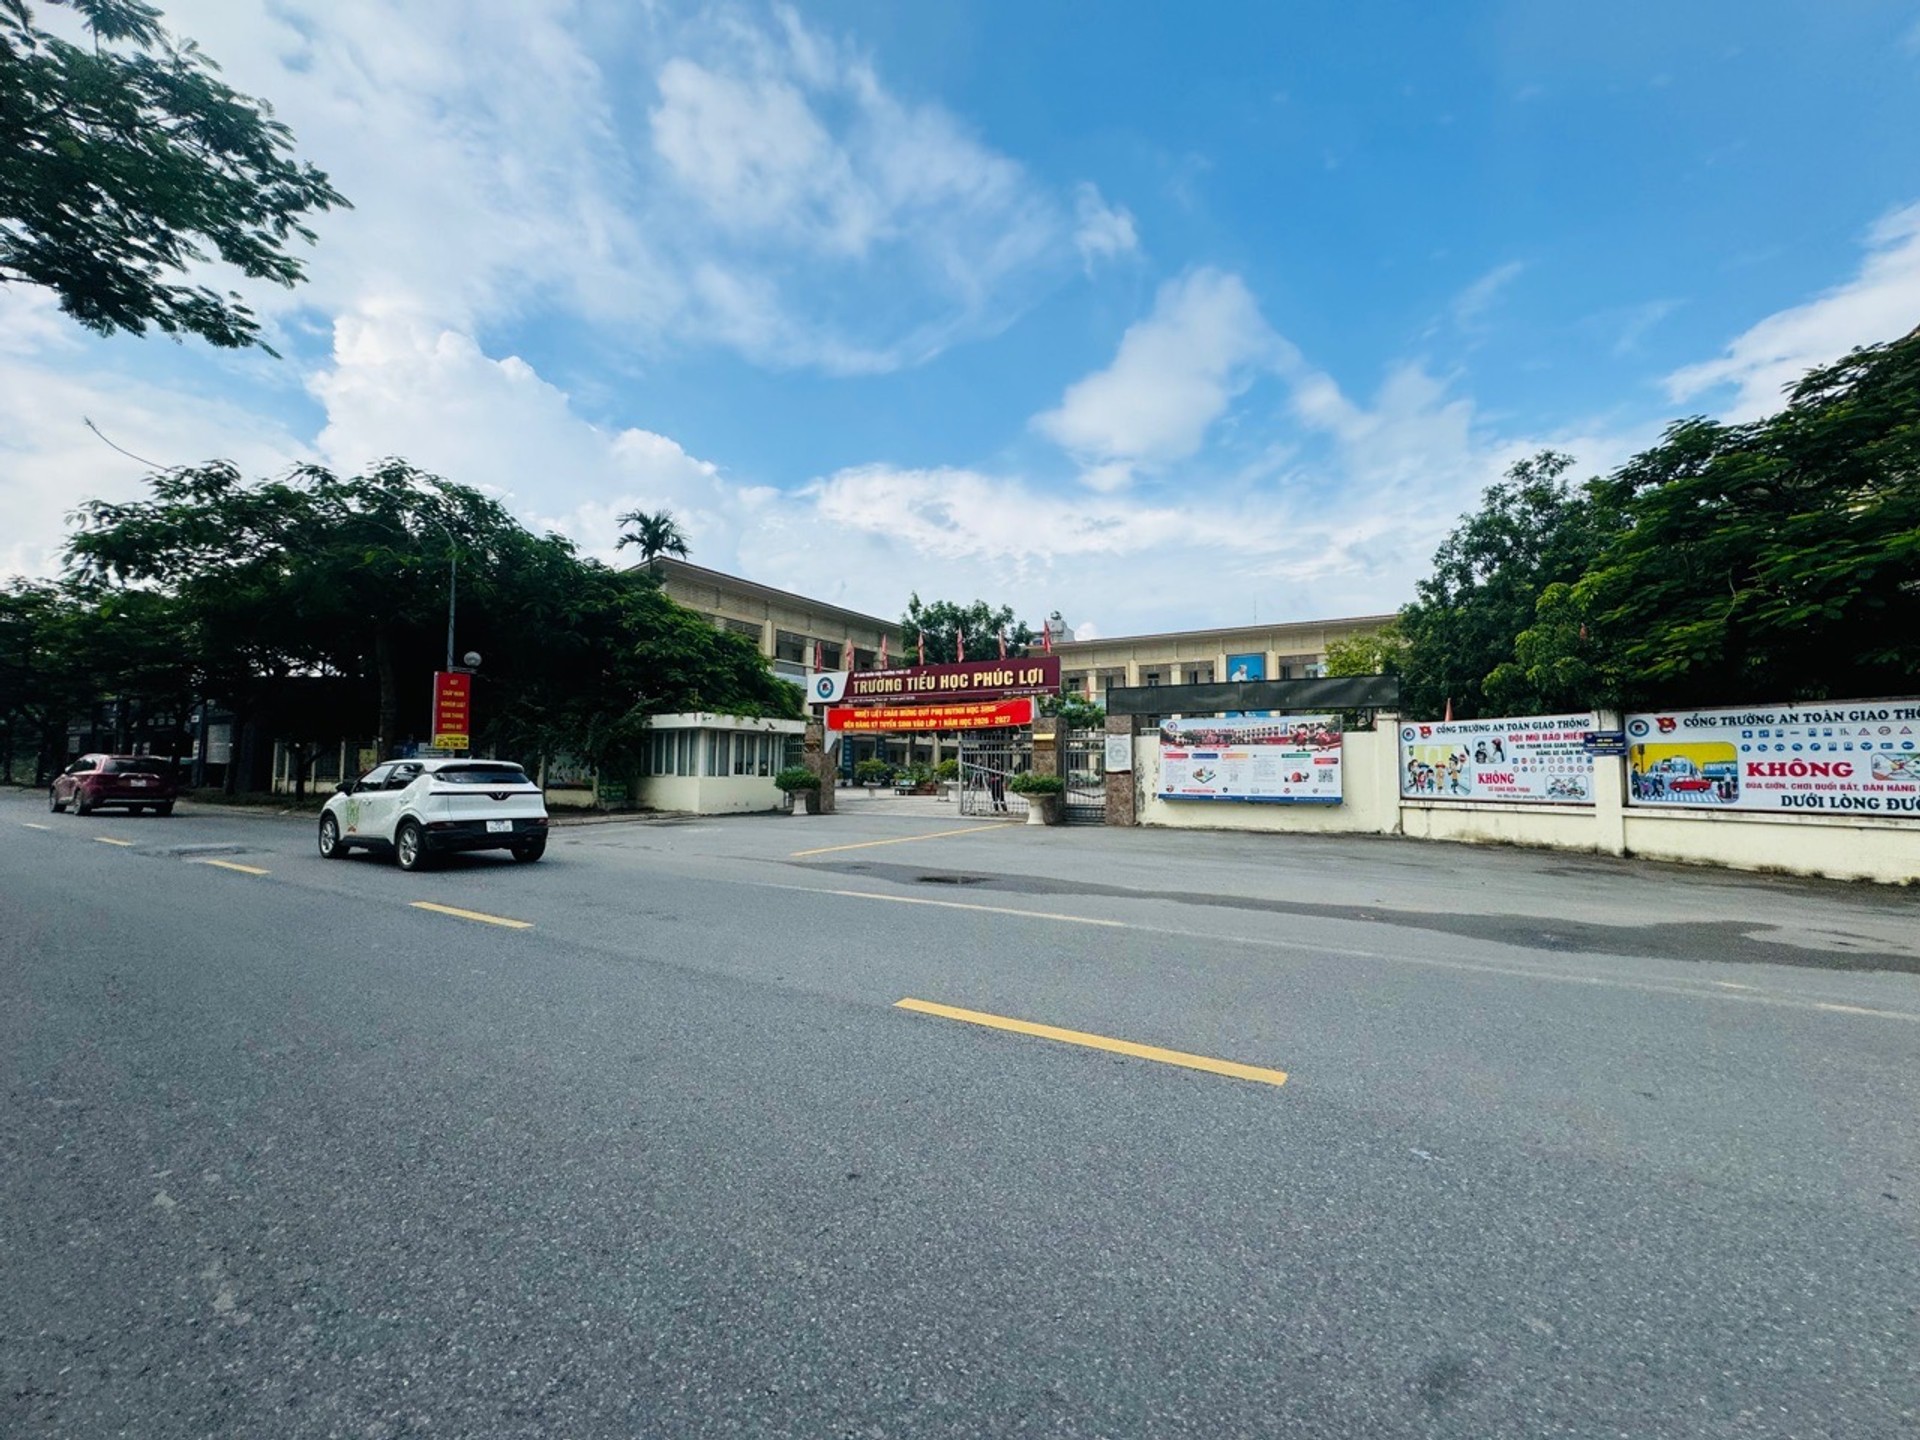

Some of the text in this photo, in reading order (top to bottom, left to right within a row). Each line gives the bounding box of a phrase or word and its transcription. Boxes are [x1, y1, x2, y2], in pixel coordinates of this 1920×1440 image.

[853, 668, 1043, 694] TRƯỜNG TIỂU HỌC PHÚC LỢI
[1458, 722, 1491, 733] TRƯỜNG
[1493, 723, 1504, 732] AN
[1507, 720, 1530, 731] TOÀN
[1532, 720, 1555, 730] GIAO
[1557, 717, 1590, 729] THÔNG
[1683, 712, 1717, 727] CỔNG
[1720, 712, 1774, 726] TRƯỜNG
[1779, 713, 1799, 724] AN
[1803, 709, 1845, 723] TOÀN
[1849, 709, 1890, 721] GIAO
[1477, 769, 1515, 784] KHÔNG
[1746, 757, 1854, 778] KHÔNG
[1791, 782, 1813, 790] CHƠI
[1887, 783, 1916, 792] HÀNG
[1781, 792, 1825, 808] DƯỚI
[1830, 793, 1880, 810] LÒNG
